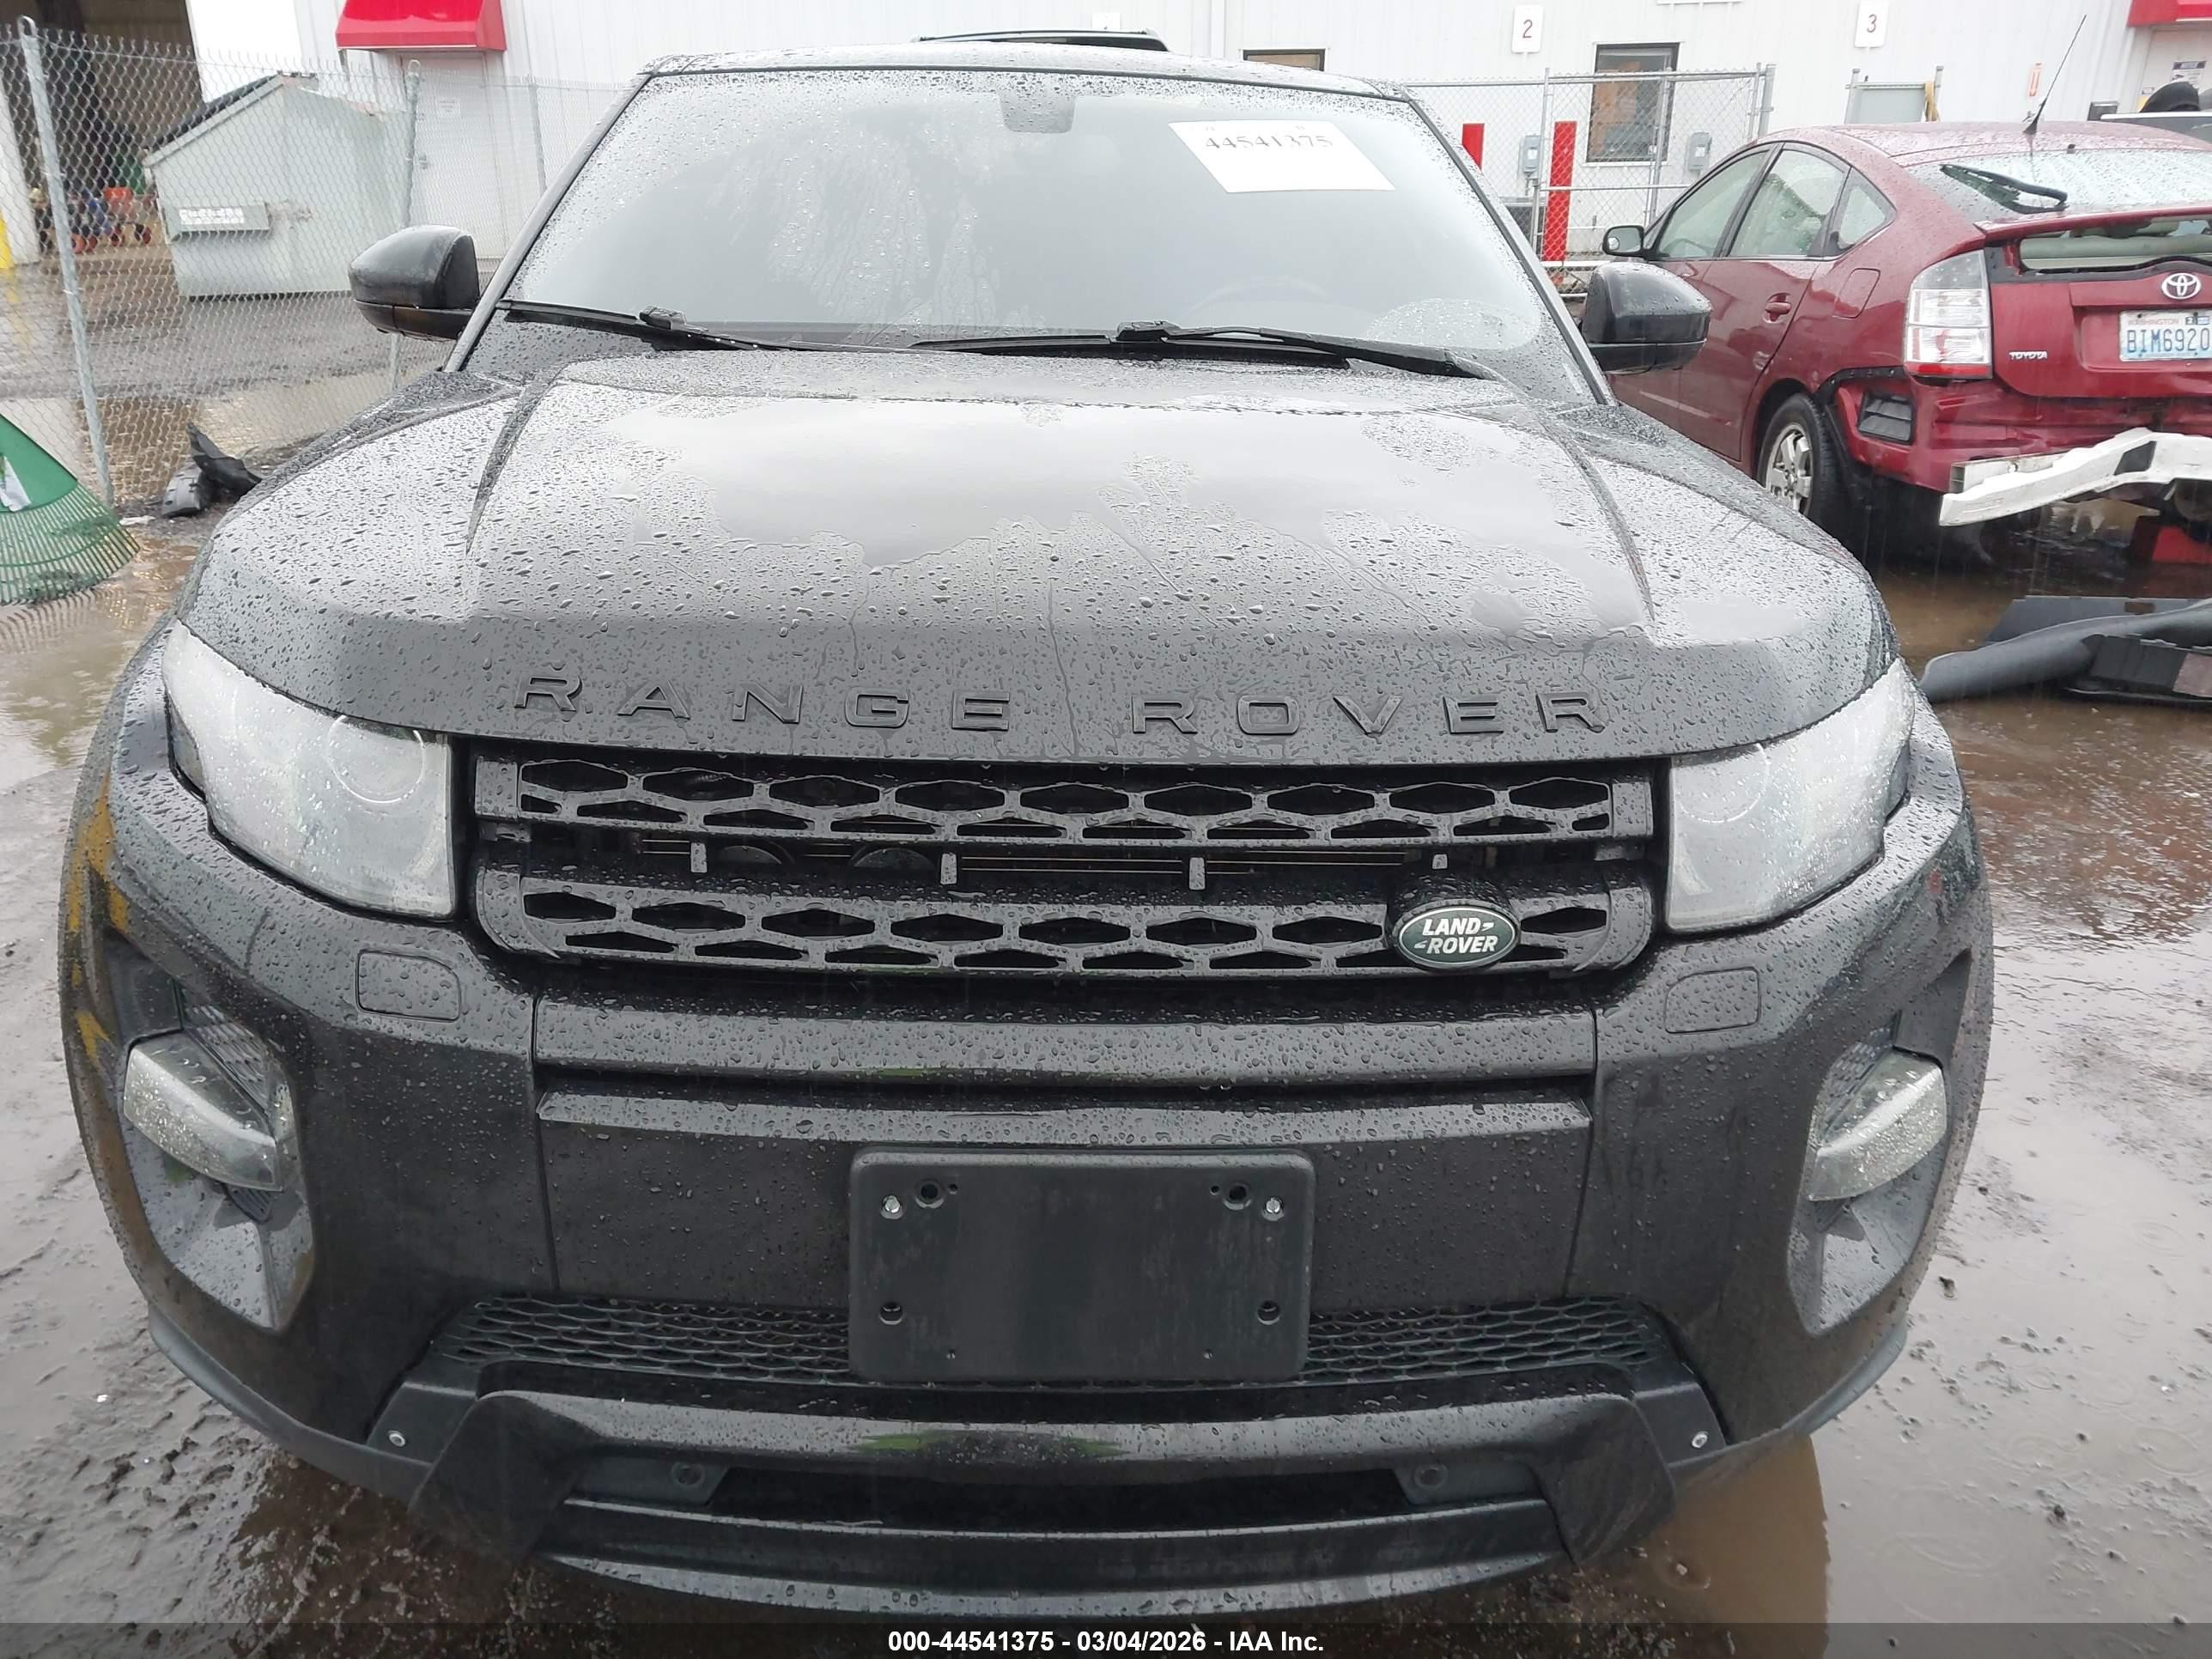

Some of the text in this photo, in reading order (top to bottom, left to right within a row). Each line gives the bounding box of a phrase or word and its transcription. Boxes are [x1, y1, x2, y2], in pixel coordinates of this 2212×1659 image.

[1522, 19, 1533, 39] 2
[1866, 14, 1877, 33] 3
[1205, 135, 1334, 149] 44541375
[2126, 328, 2210, 353] BIM6920
[2008, 351, 2048, 361] TOYOTA
[514, 675, 1606, 735] RANGE ROVER
